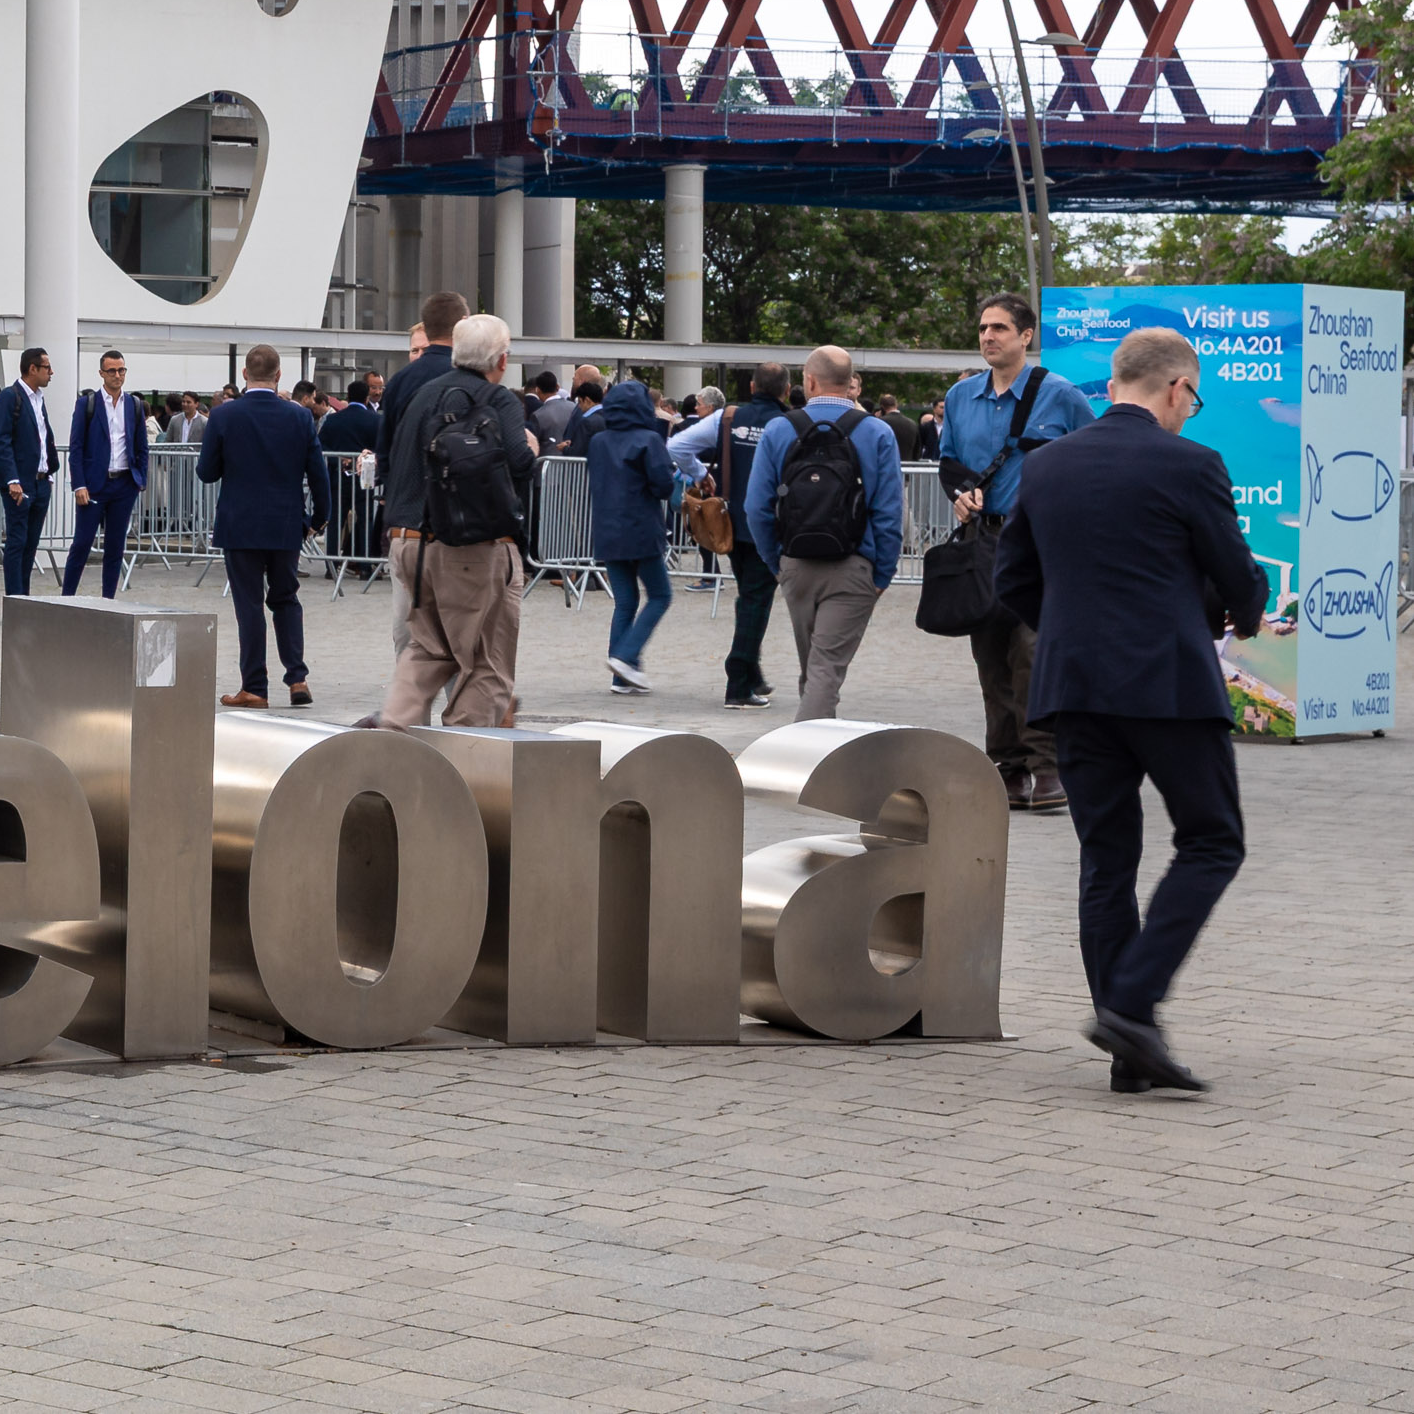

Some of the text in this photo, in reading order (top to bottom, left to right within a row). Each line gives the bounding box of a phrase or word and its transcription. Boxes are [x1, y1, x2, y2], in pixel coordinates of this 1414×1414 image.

[1056, 307, 1110, 319] Zhoushan
[1082, 317, 1131, 329] Seafood
[1183, 305, 1271, 329] Visit us
[1309, 305, 1373, 336] Zhoushan
[1056, 325, 1089, 337] China
[1340, 341, 1398, 372] Seafood
[1217, 362, 1284, 382] 4B201
[1308, 364, 1347, 395] China
[1366, 672, 1390, 691] 4B201
[1304, 696, 1390, 721] Visit us No.4A201
